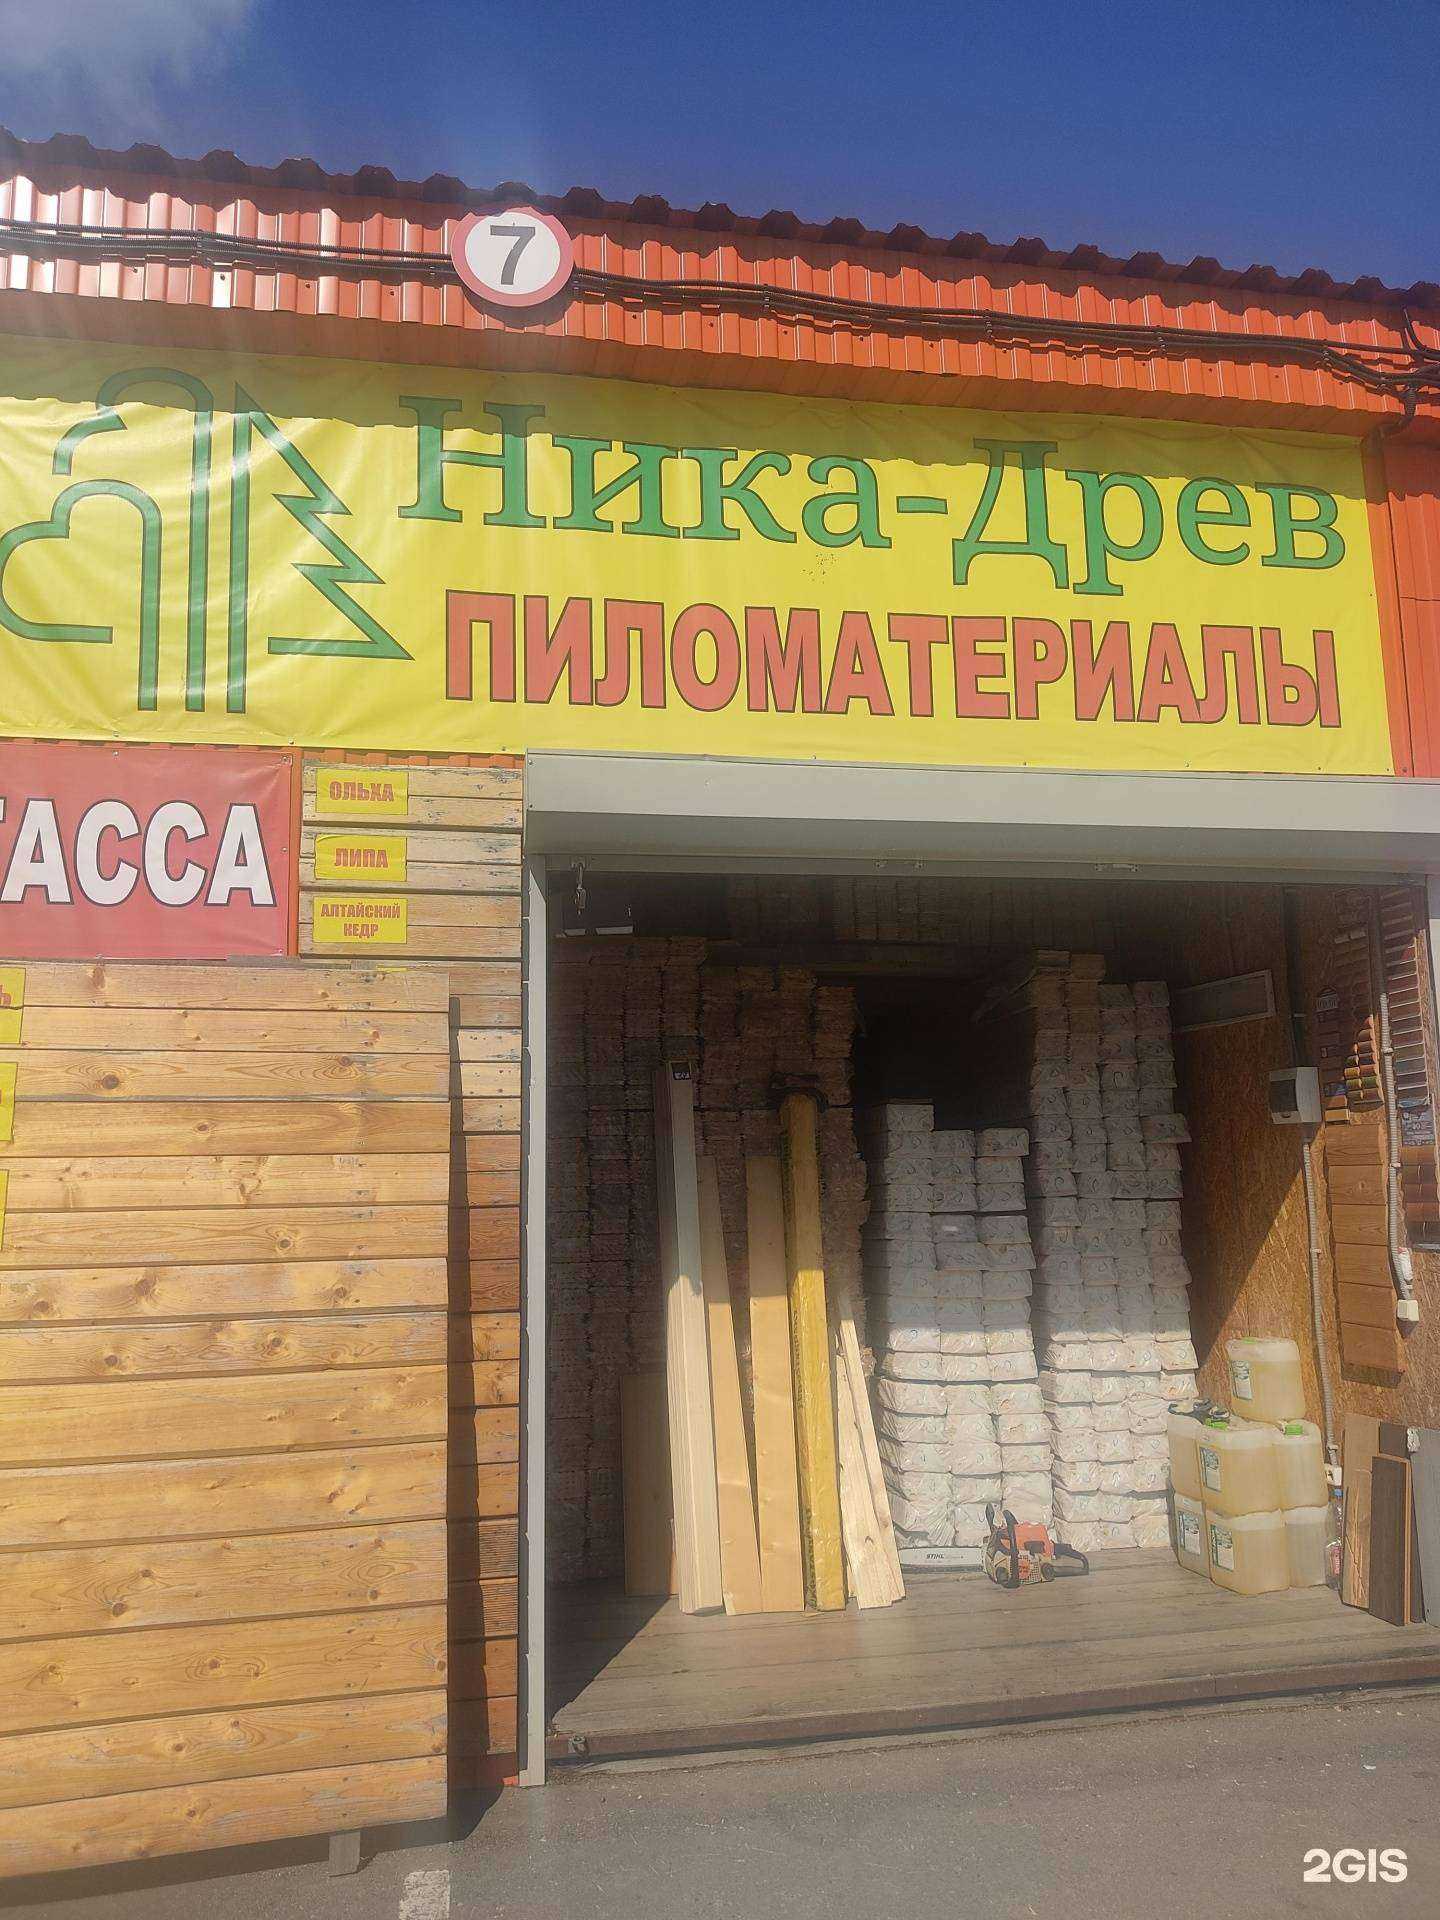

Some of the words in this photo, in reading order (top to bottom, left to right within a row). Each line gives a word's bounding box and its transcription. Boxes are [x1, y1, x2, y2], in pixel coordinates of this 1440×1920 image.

[489, 224, 537, 286] 7
[397, 394, 1347, 597] Ника-Древ
[444, 588, 1343, 729] ПИЛОМАТЕРИАЛЫ
[329, 780, 395, 802] ОЛЬХА
[0, 797, 277, 907] АССА
[333, 847, 389, 868] ЛИПА
